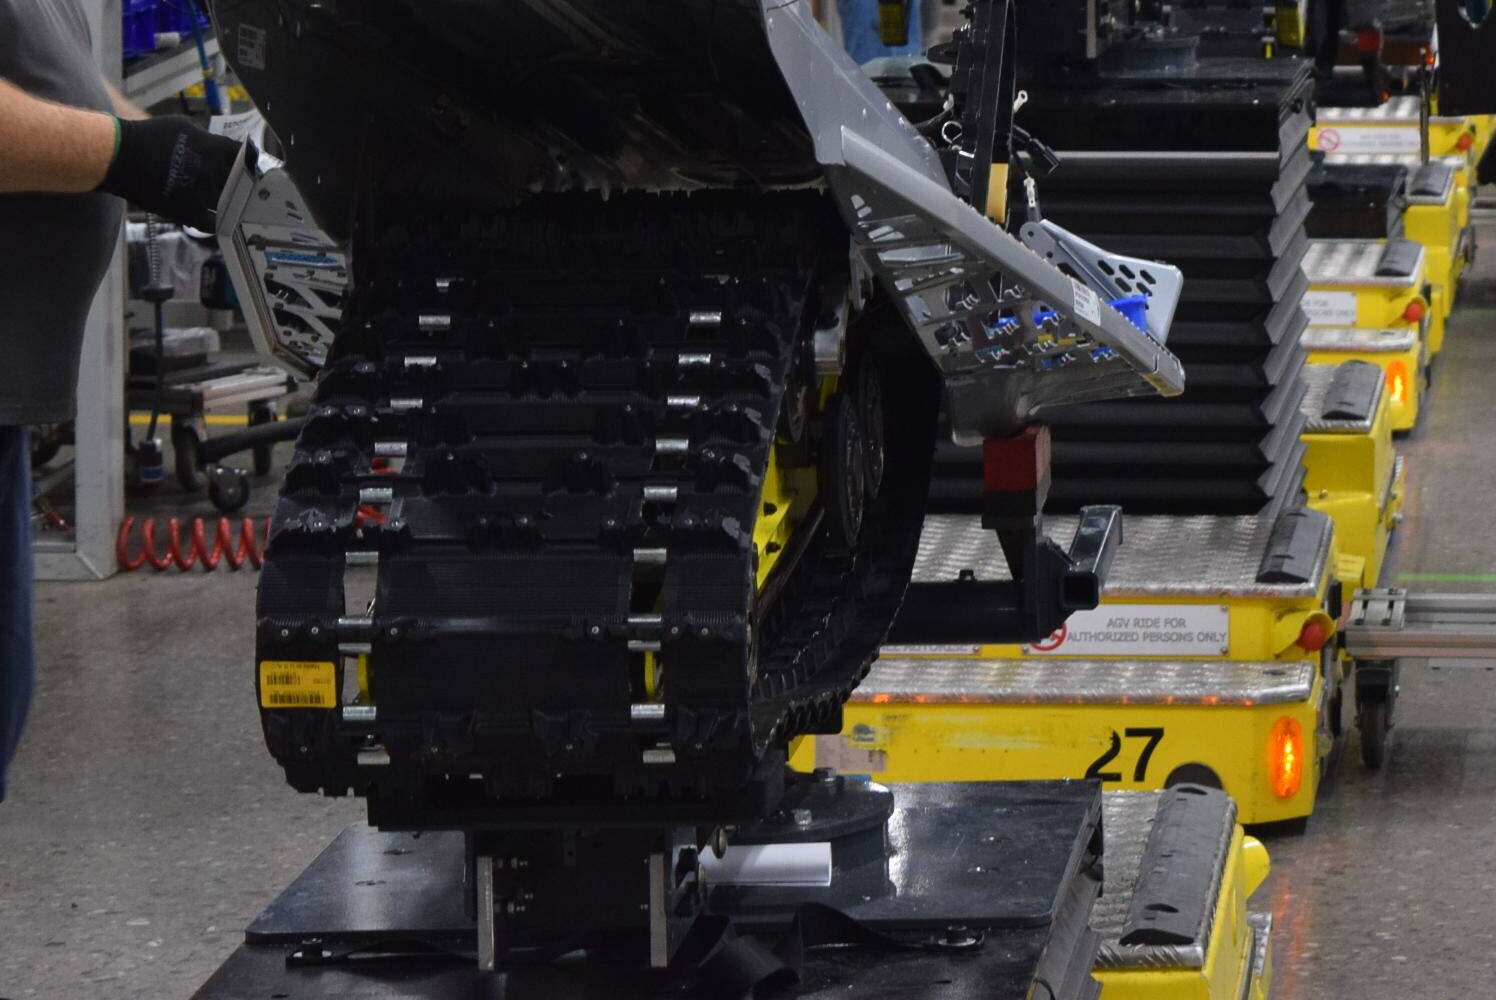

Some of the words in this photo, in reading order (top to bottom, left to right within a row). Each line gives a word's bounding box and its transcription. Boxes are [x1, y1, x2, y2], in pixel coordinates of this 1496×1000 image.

[1107, 618, 1130, 628] AGV
[1134, 618, 1160, 628] RIDE
[1164, 618, 1186, 628] FOR
[1067, 631, 1138, 642] AUTHORIZED
[1143, 631, 1193, 642] PERSONS
[1197, 631, 1227, 642] ONLY
[1084, 727, 1165, 782] 27
